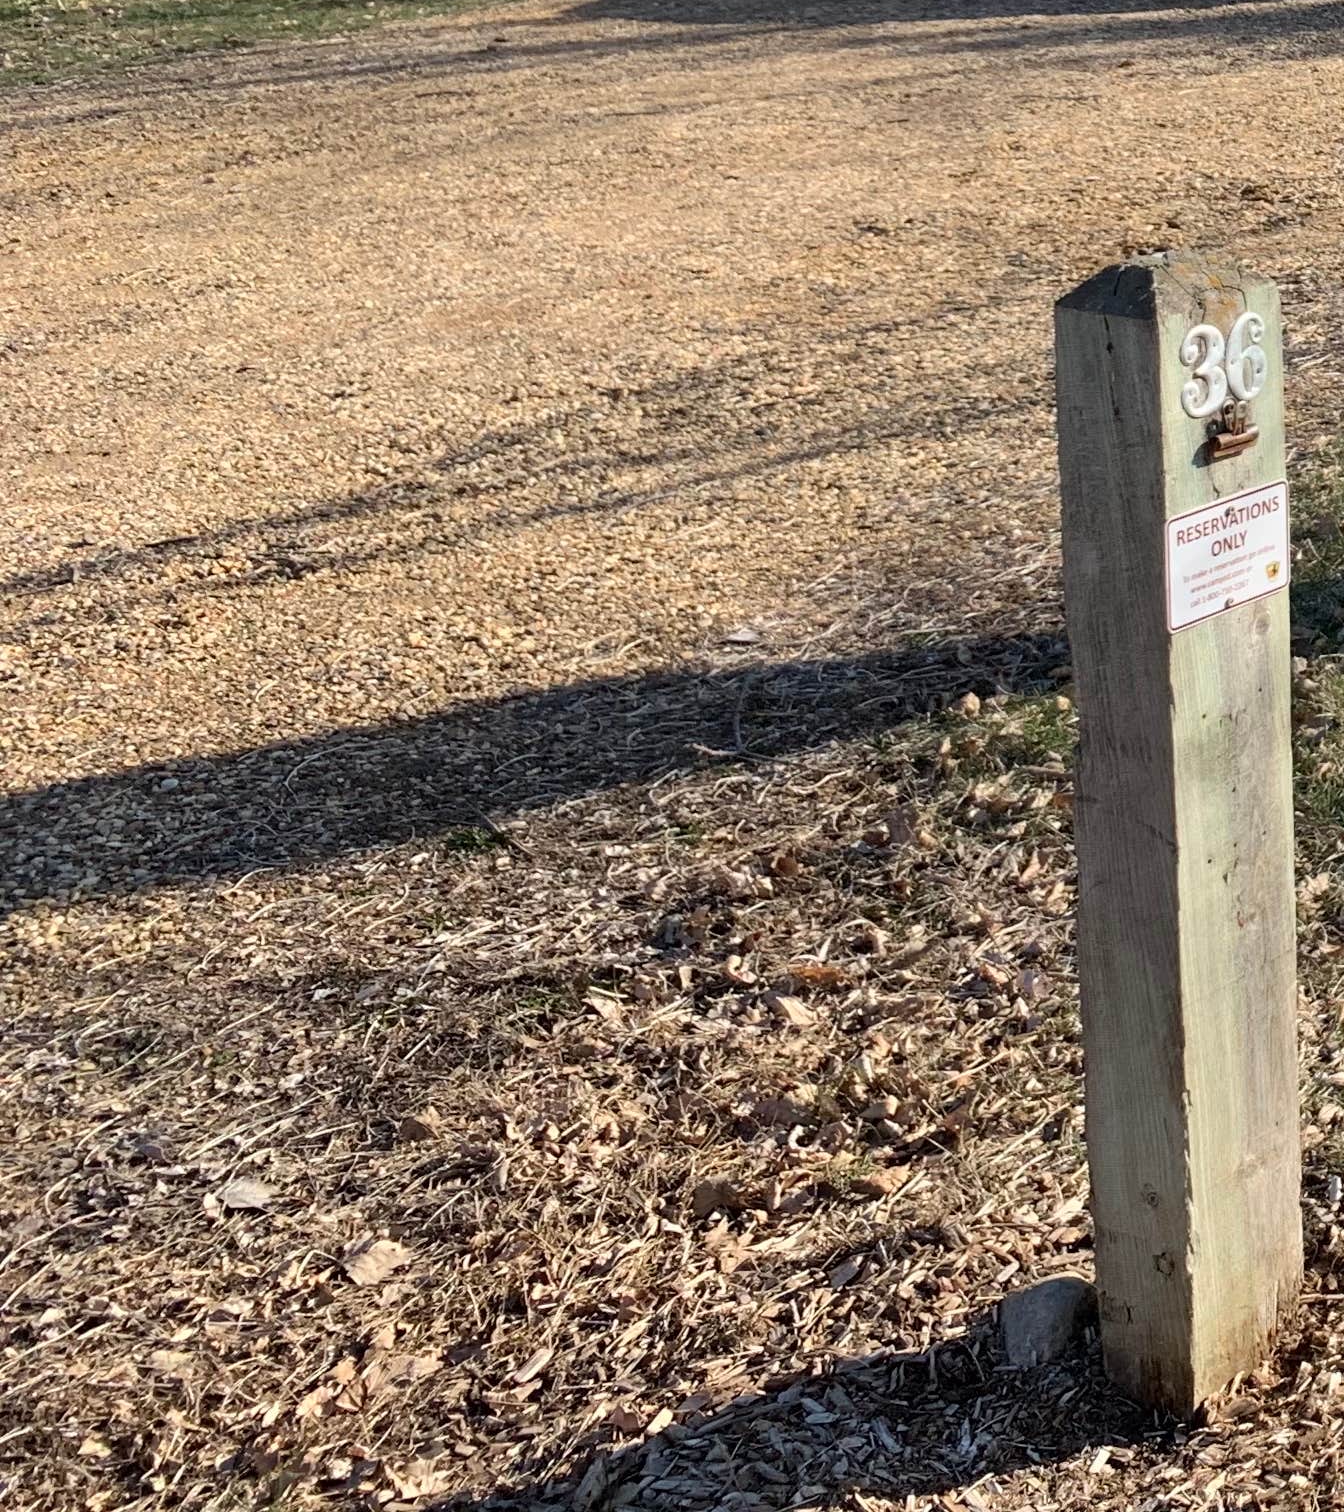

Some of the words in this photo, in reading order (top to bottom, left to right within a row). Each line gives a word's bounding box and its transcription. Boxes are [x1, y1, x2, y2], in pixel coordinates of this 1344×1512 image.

[1180, 312, 1266, 418] 36
[1176, 496, 1280, 546] RESERVATIONS
[1211, 530, 1248, 557] ONLY
